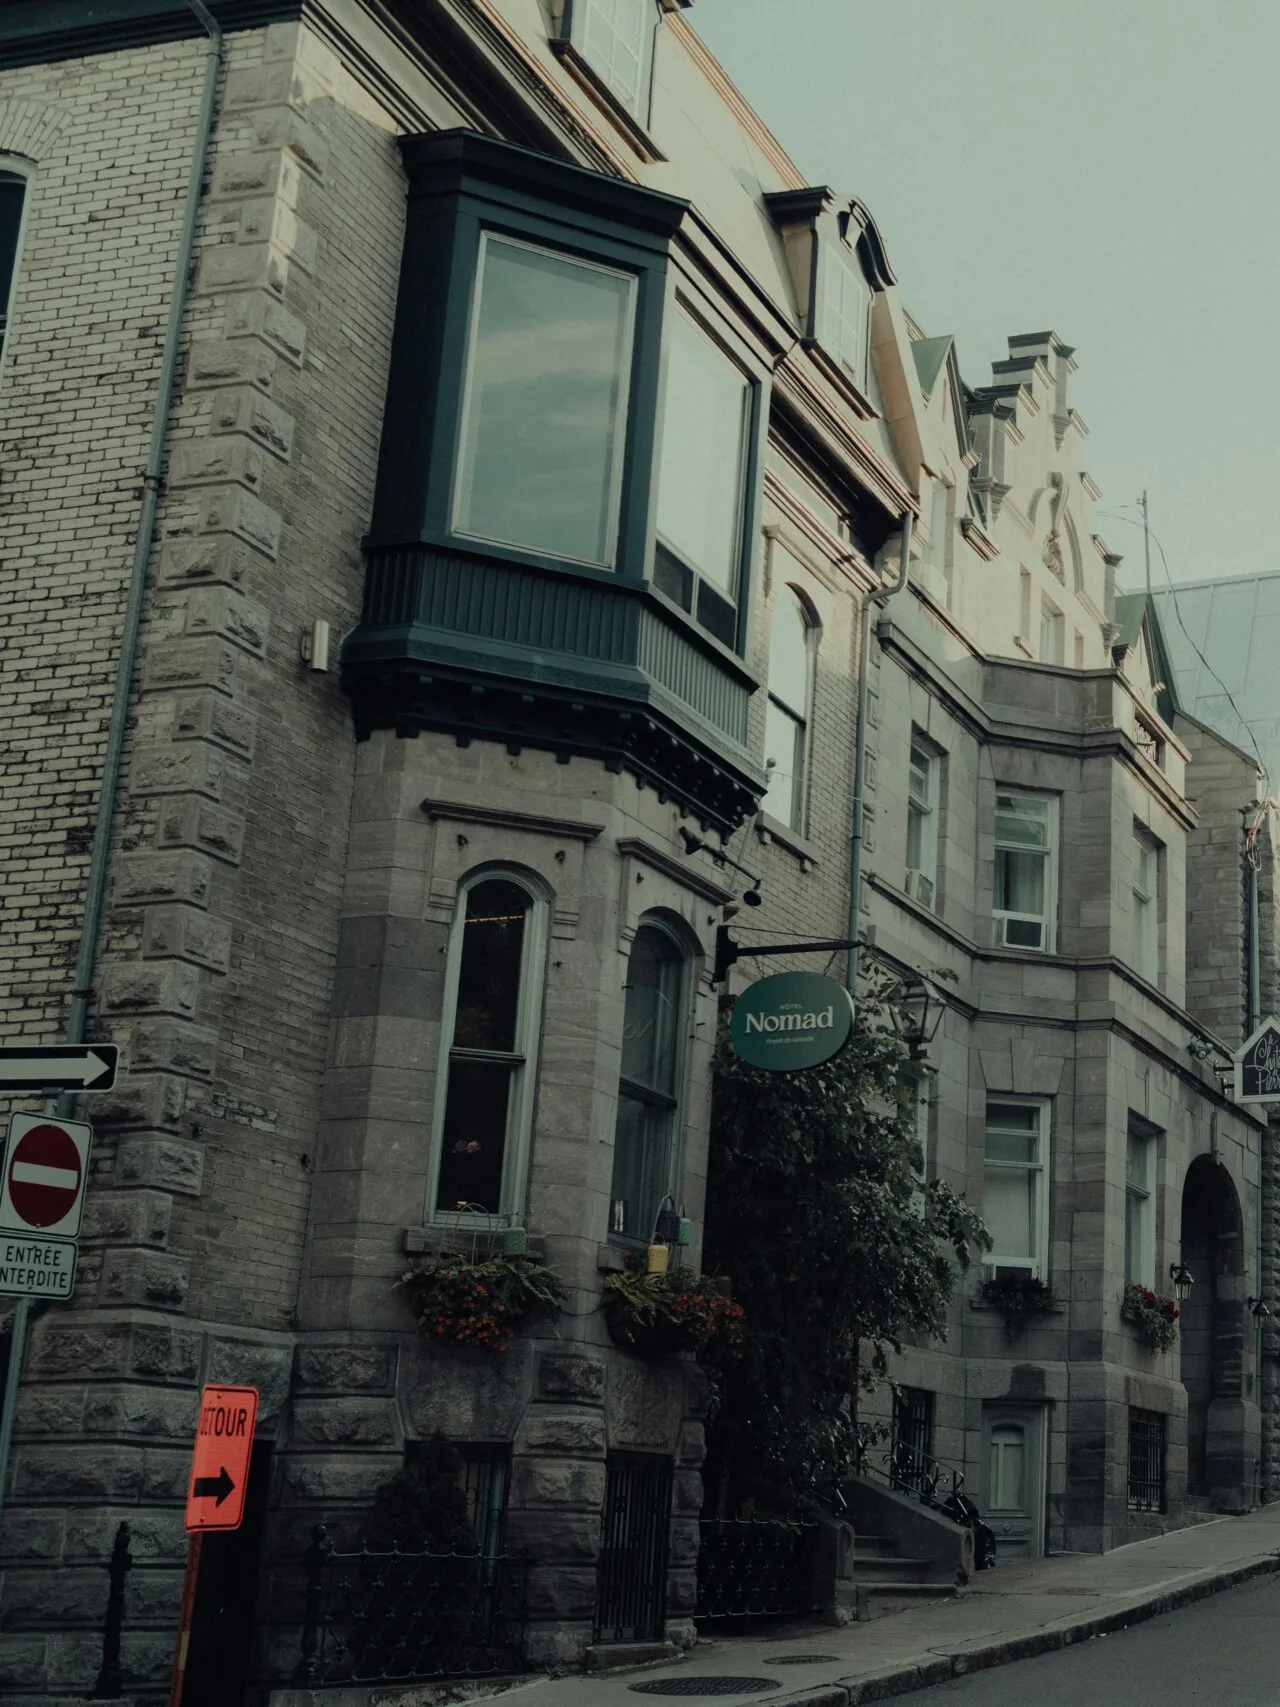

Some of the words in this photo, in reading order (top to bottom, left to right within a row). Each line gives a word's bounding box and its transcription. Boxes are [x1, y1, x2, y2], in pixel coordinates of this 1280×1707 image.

[744, 1006, 834, 1033] Nomad
[6, 1245, 62, 1266] ENTRÉE
[0, 1267, 68, 1288] NTERDITE
